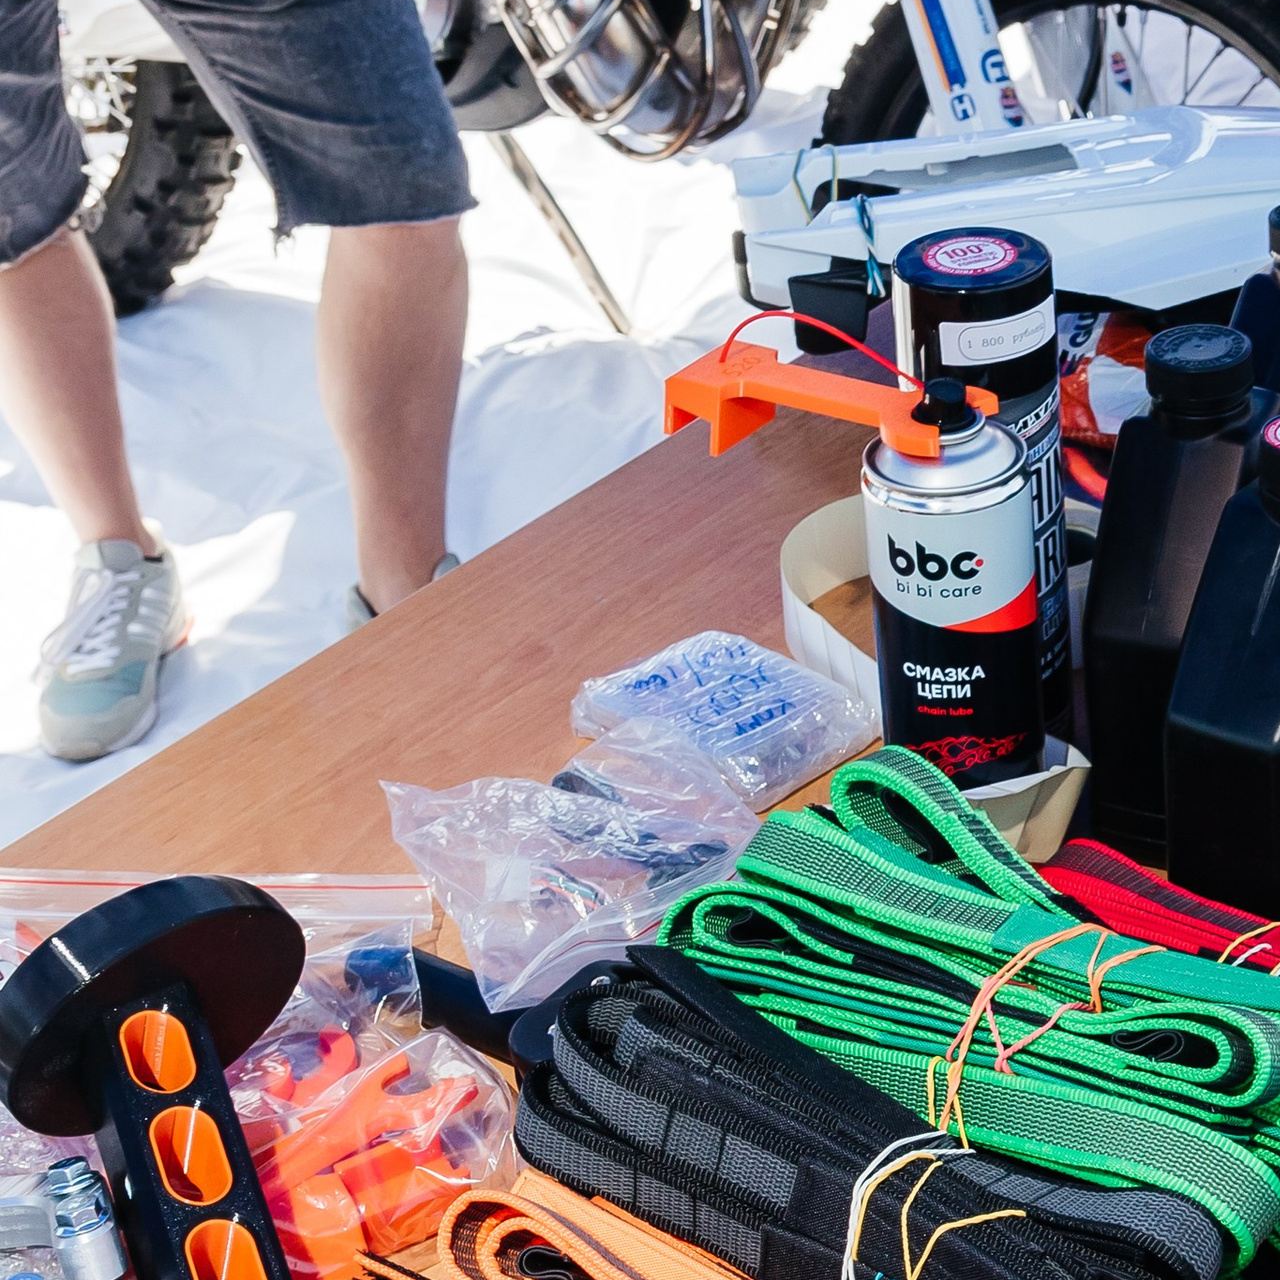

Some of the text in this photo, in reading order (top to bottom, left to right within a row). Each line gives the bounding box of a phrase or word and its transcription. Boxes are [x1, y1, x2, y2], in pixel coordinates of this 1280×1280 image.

[966, 339, 973, 349] 1
[981, 336, 1004, 348] 800
[887, 533, 983, 582] bbc
[896, 579, 983, 599] bi bi care
[902, 661, 986, 684] СМАЗКА
[917, 681, 972, 700] ЦЕПИ
[917, 704, 974, 716] chain lube
